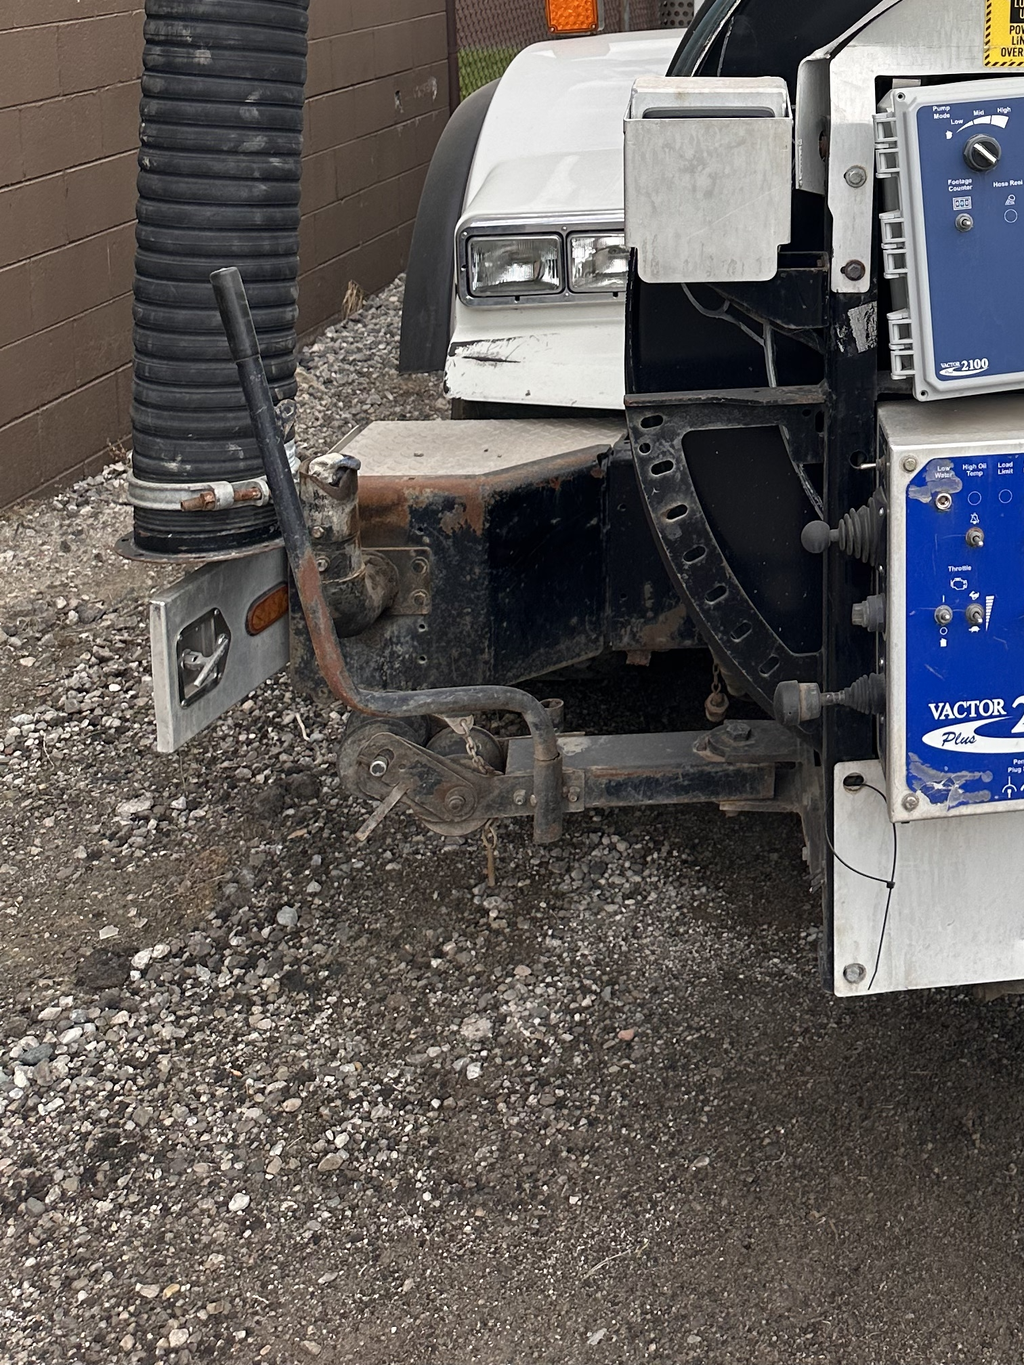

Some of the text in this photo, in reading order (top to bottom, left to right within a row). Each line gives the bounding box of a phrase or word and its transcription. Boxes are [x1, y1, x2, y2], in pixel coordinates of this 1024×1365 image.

[961, 358, 989, 370] 2100
[929, 698, 1007, 720] VACTOR
[941, 731, 977, 747] Plus
[1007, 766, 1022, 774] Plug
